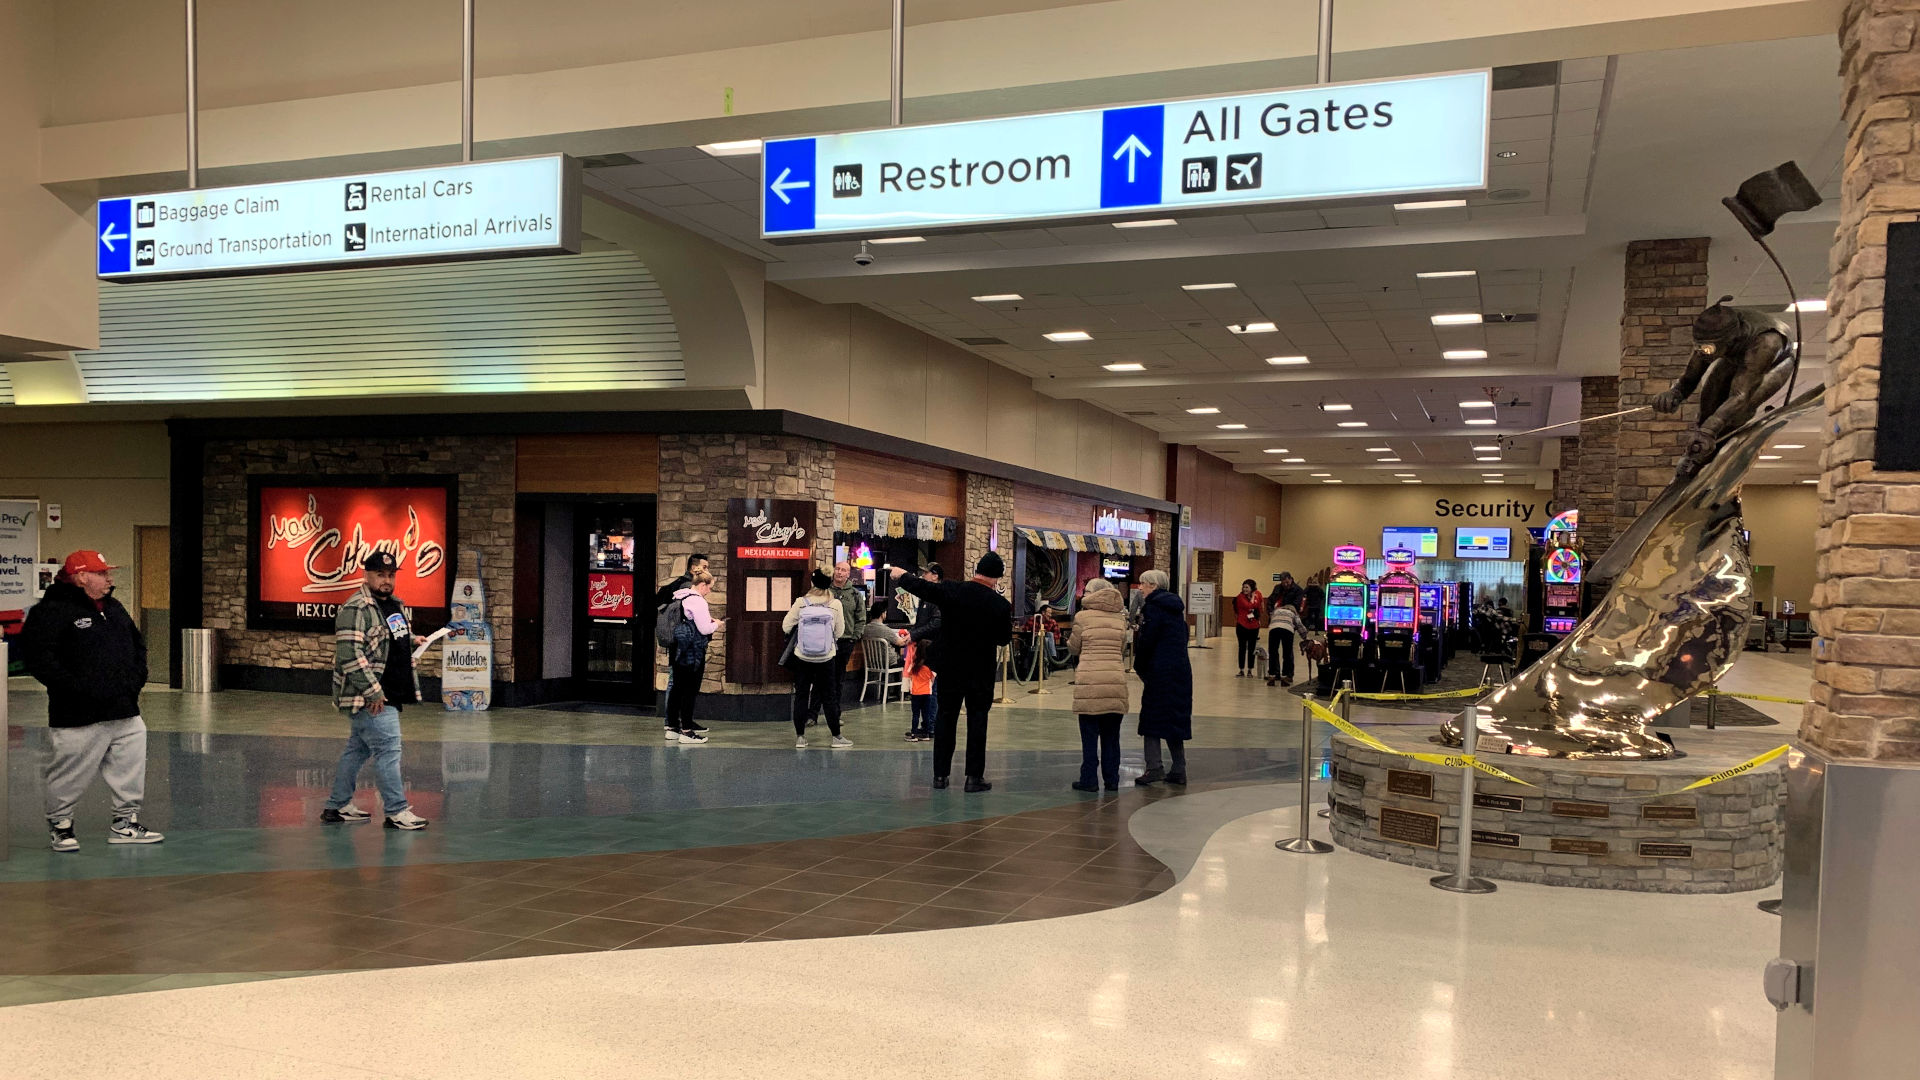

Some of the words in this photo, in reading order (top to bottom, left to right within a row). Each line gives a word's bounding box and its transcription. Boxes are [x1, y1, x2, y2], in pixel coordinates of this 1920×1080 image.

[1184, 105, 1241, 144] All
[1260, 99, 1394, 138] Gates
[880, 153, 1071, 194] Restroom
[371, 181, 427, 203] Rental
[433, 179, 473, 197] Cars
[159, 202, 229, 223] Baggage
[234, 196, 280, 215] Claim
[370, 218, 478, 244] International
[484, 212, 553, 234] Arrivals
[158, 239, 213, 258] Ground
[218, 230, 333, 254] Transportation
[1434, 498, 1536, 522] Security
